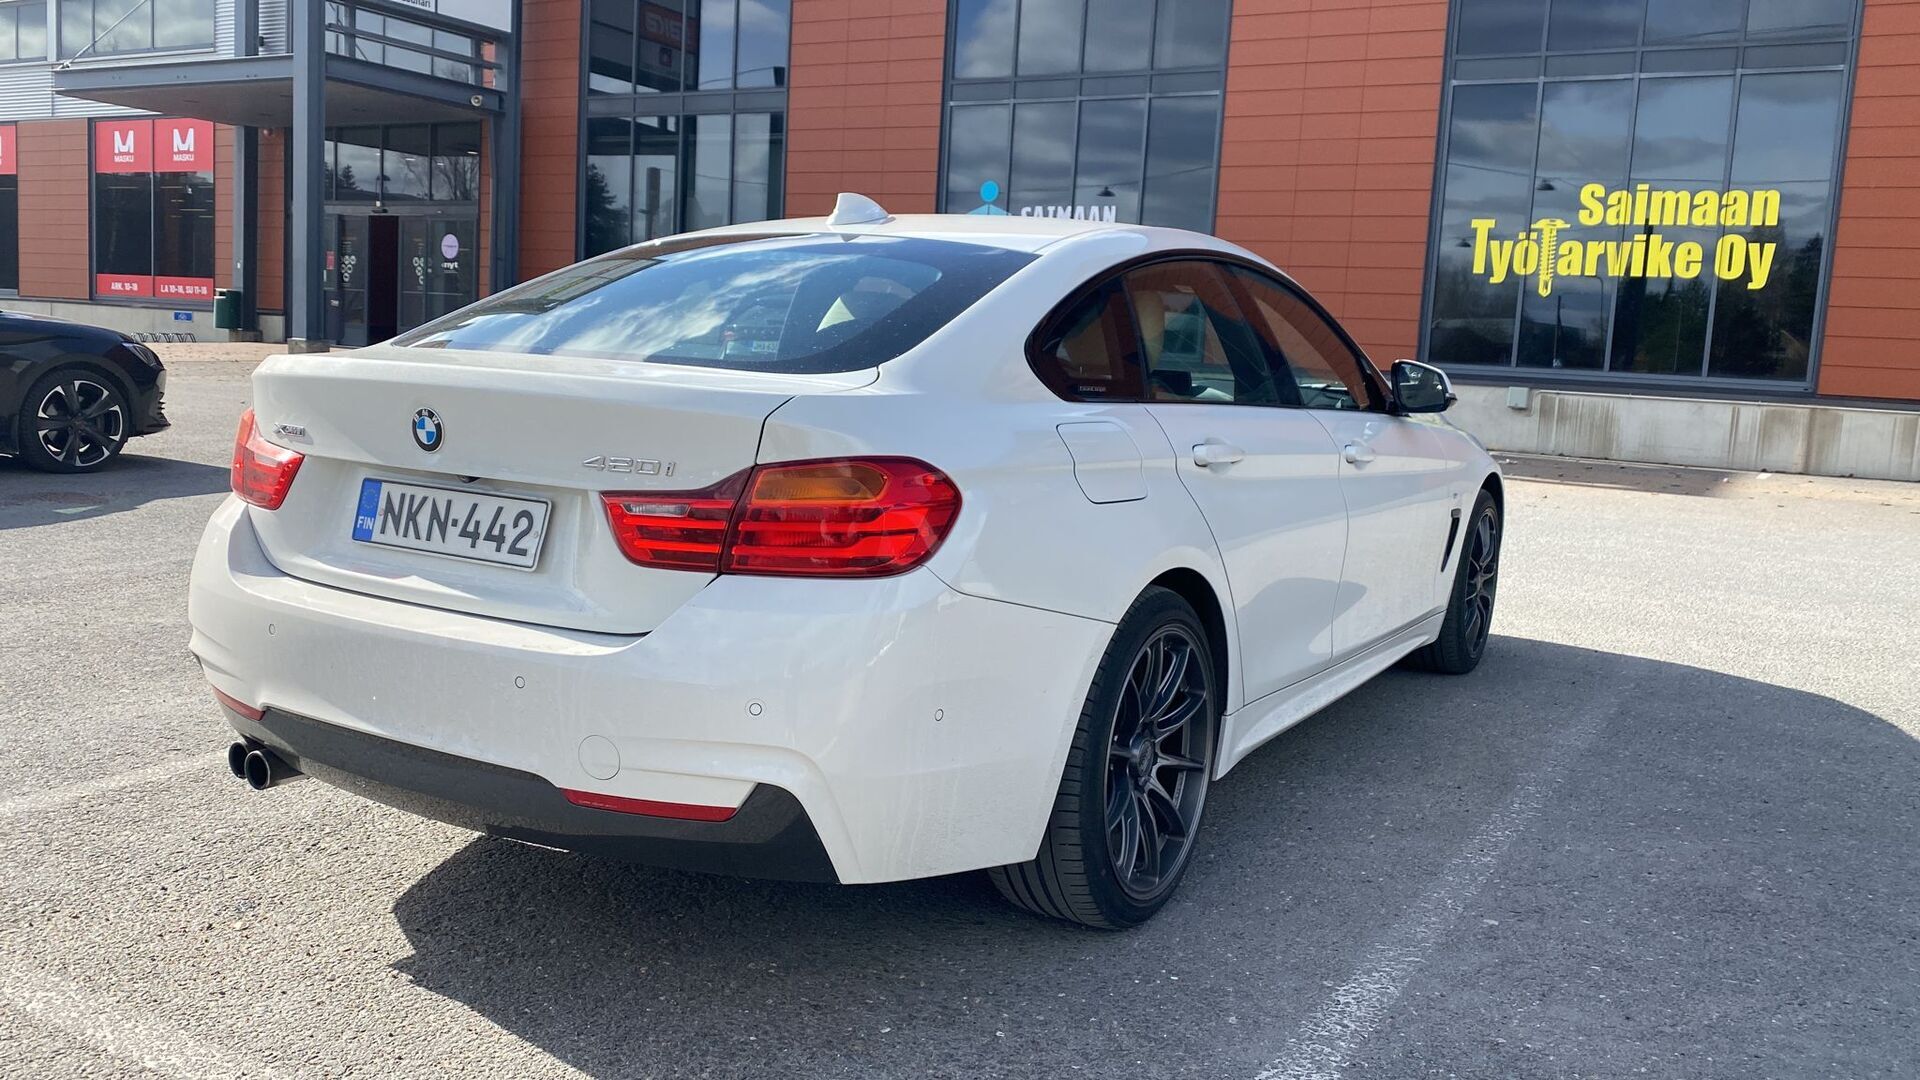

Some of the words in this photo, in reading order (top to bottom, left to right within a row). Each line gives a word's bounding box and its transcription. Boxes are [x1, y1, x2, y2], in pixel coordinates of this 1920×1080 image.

[173, 153, 194, 161] MASKU
[1578, 183, 1781, 226] Saimaan
[1714, 233, 1777, 290] Oy
[356, 515, 375, 530] FIN
[379, 491, 534, 557] NKN-442
